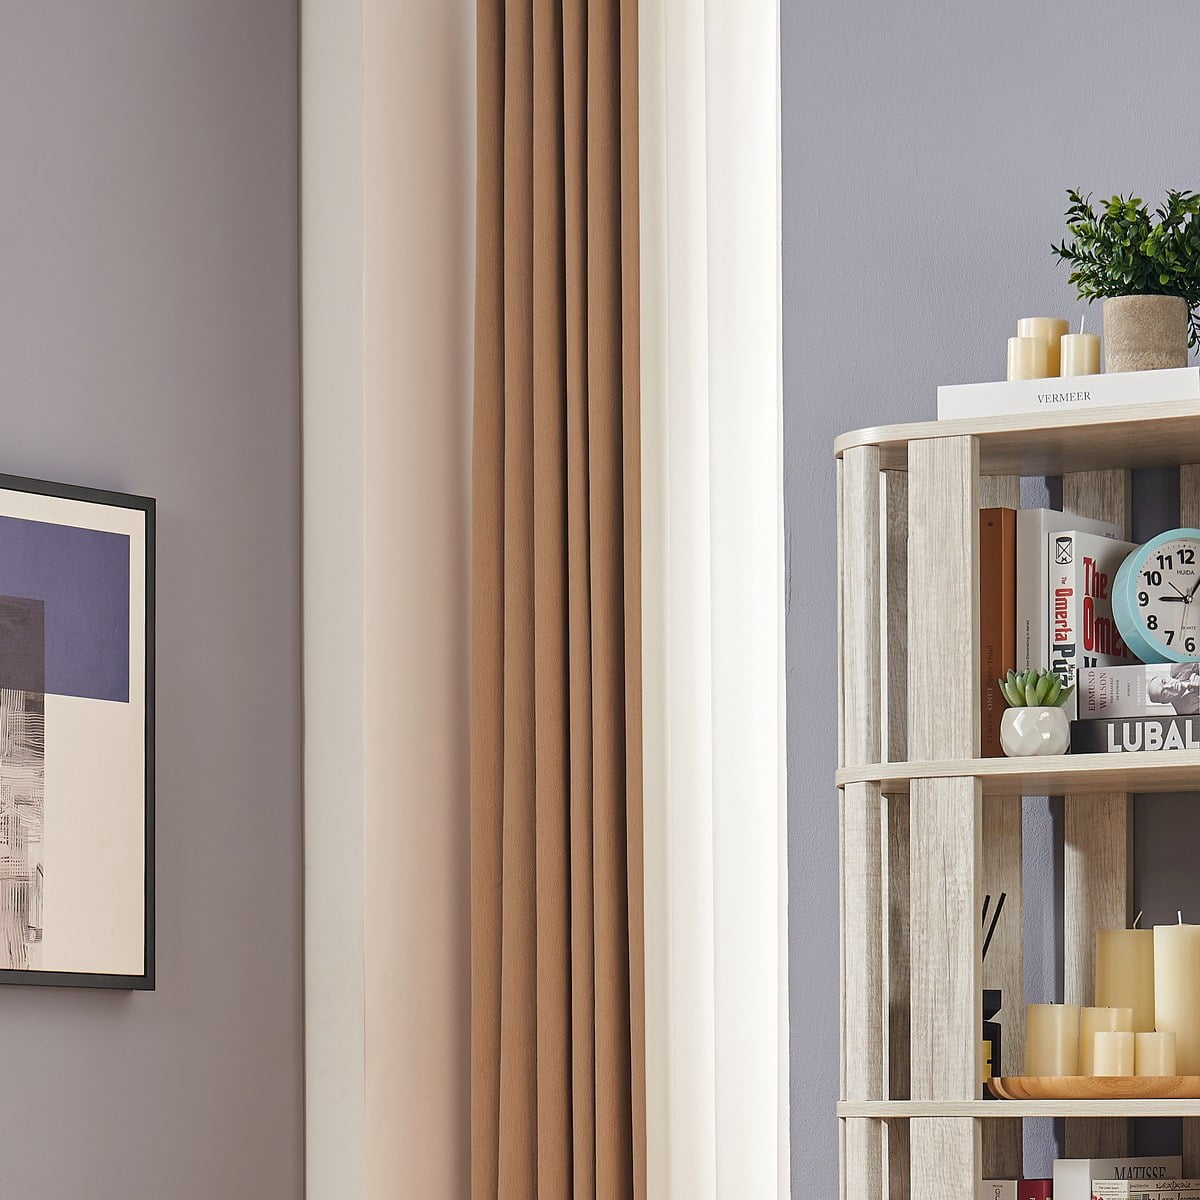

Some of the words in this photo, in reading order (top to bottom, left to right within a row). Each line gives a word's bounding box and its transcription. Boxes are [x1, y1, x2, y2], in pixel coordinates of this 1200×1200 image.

[1037, 391, 1091, 404] VERMEER
[1156, 555, 1173, 570] 11
[1176, 549, 1196, 565] 12
[1083, 556, 1109, 601] The
[1143, 571, 1162, 586] 10
[1138, 592, 1149, 607] 9
[1055, 588, 1073, 642] Omerta
[1147, 615, 1158, 630] 8
[1164, 631, 1175, 646] 7
[1184, 637, 1196, 652] 6
[1088, 671, 1096, 711] EDMUND
[1099, 672, 1107, 709] WILSON
